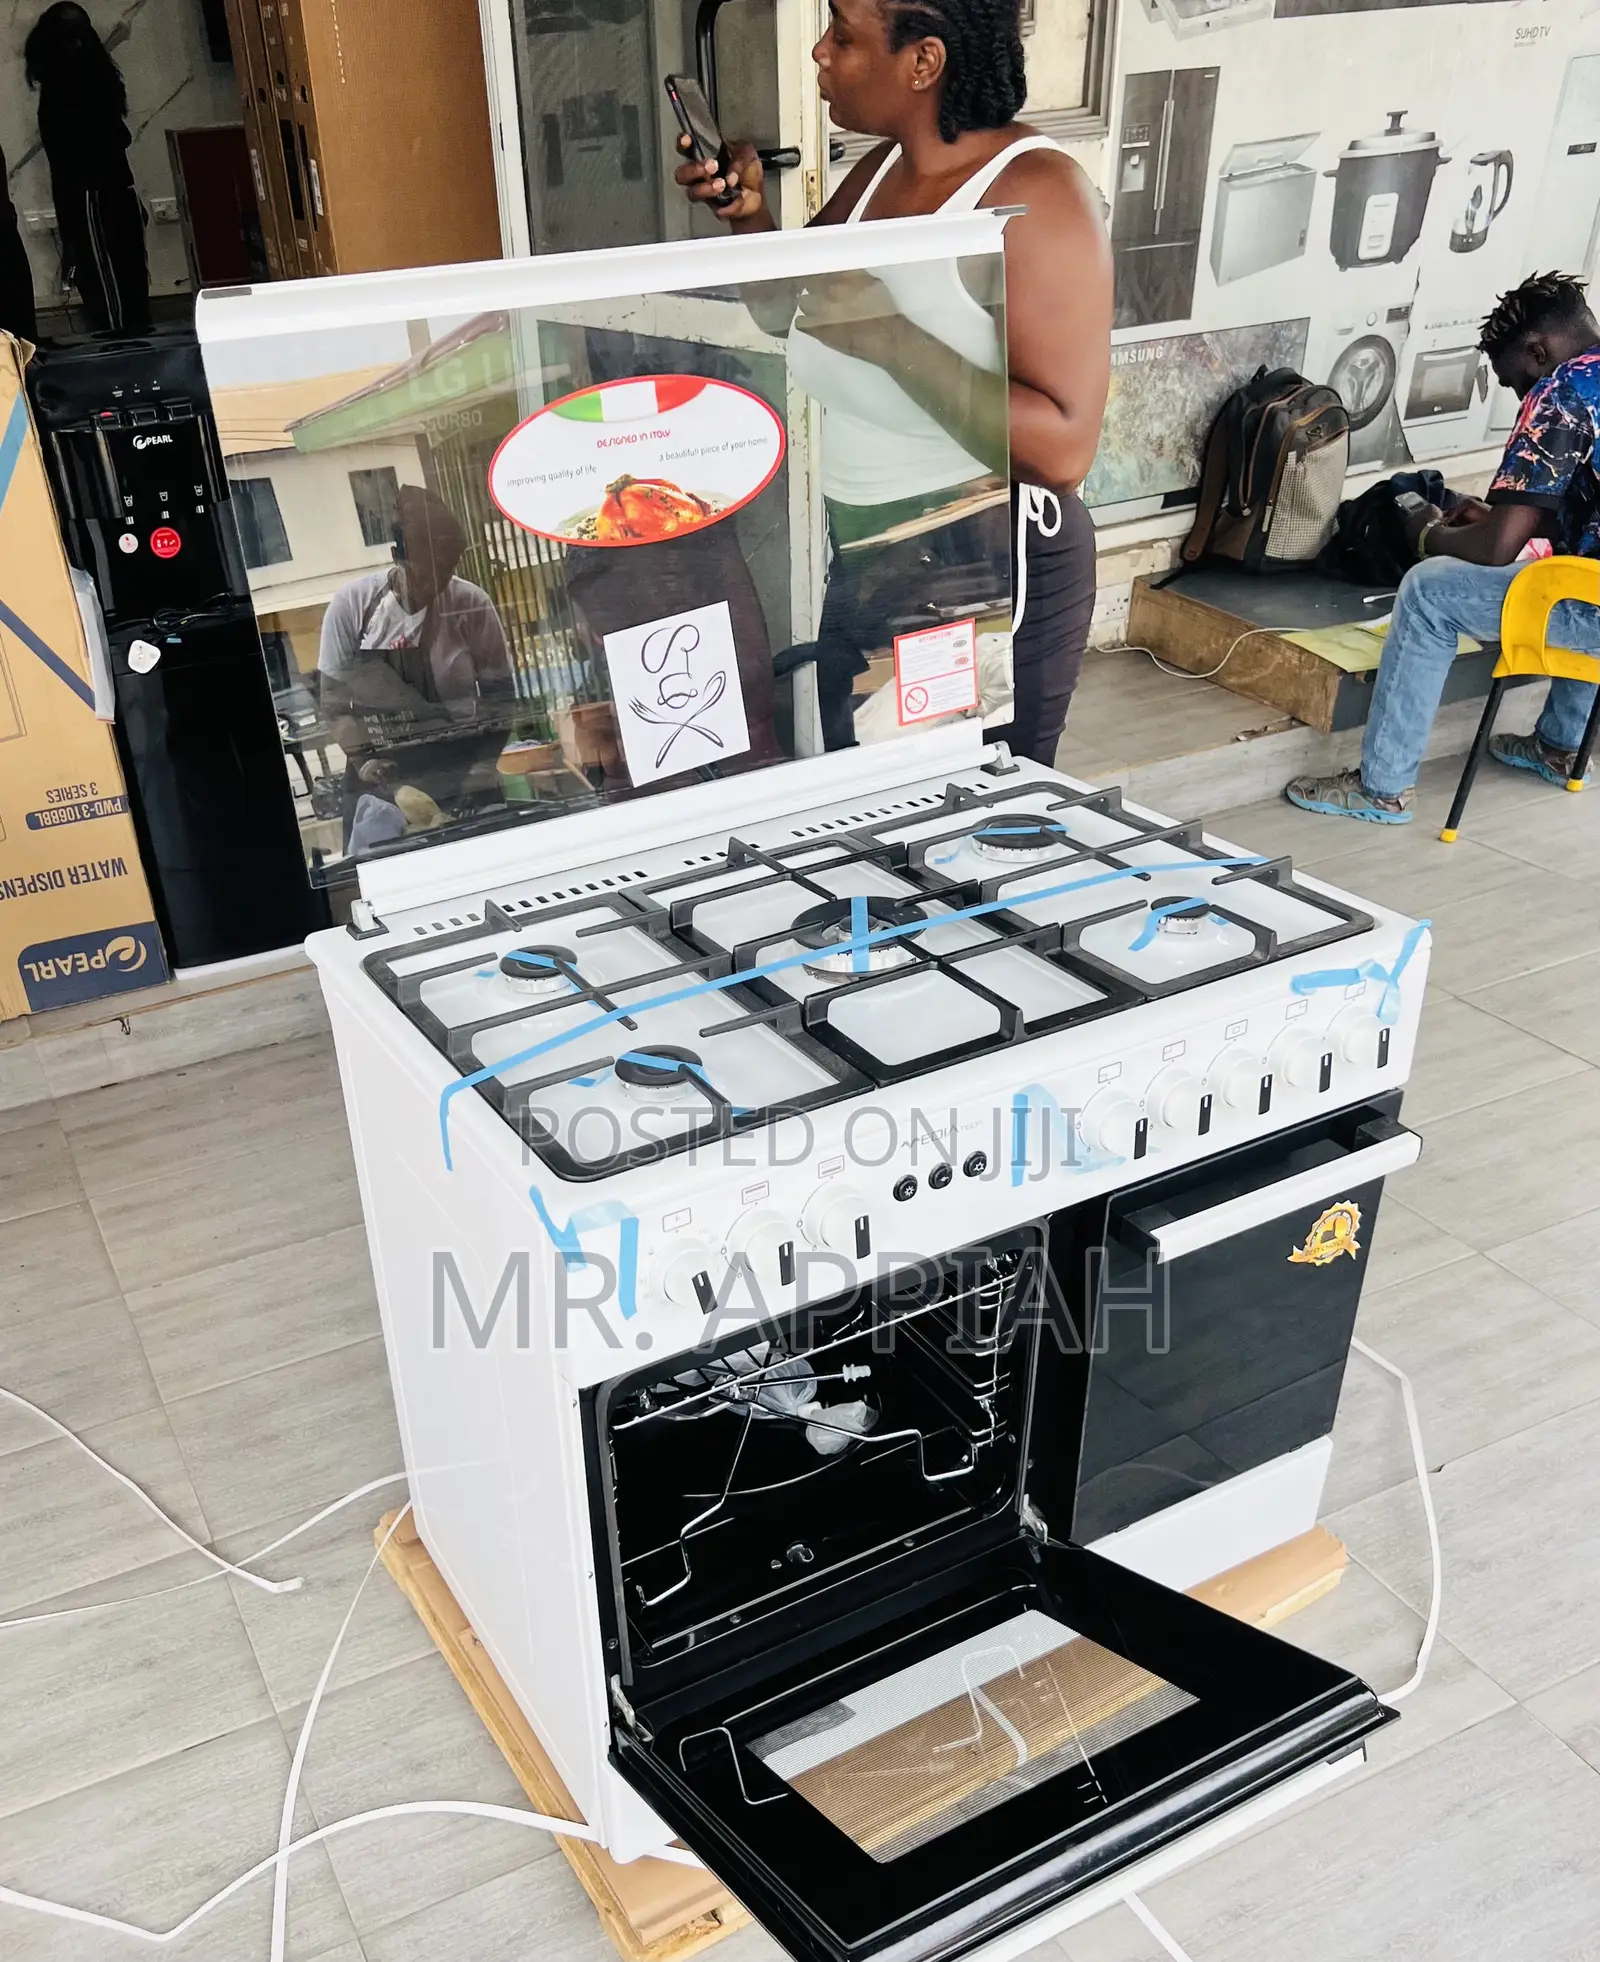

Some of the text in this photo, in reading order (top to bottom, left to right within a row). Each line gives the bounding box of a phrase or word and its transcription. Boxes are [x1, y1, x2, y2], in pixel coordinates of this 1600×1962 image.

[1515, 25, 1551, 39] SUHD TV
[1111, 346, 1164, 365] AMSUNG
[146, 434, 173, 446] PEARL
[597, 434, 638, 448] DESIGNED
[639, 432, 648, 441] IN
[700, 445, 720, 456] piece
[721, 442, 729, 452] of
[730, 440, 747, 452] your
[748, 436, 768, 447] home
[507, 463, 597, 487] improving quality of life
[46, 782, 99, 804] 3 SERIES
[35, 798, 122, 827] PWD-3106BBL
[68, 857, 129, 885] WATER
[24, 949, 107, 983] PEARL
